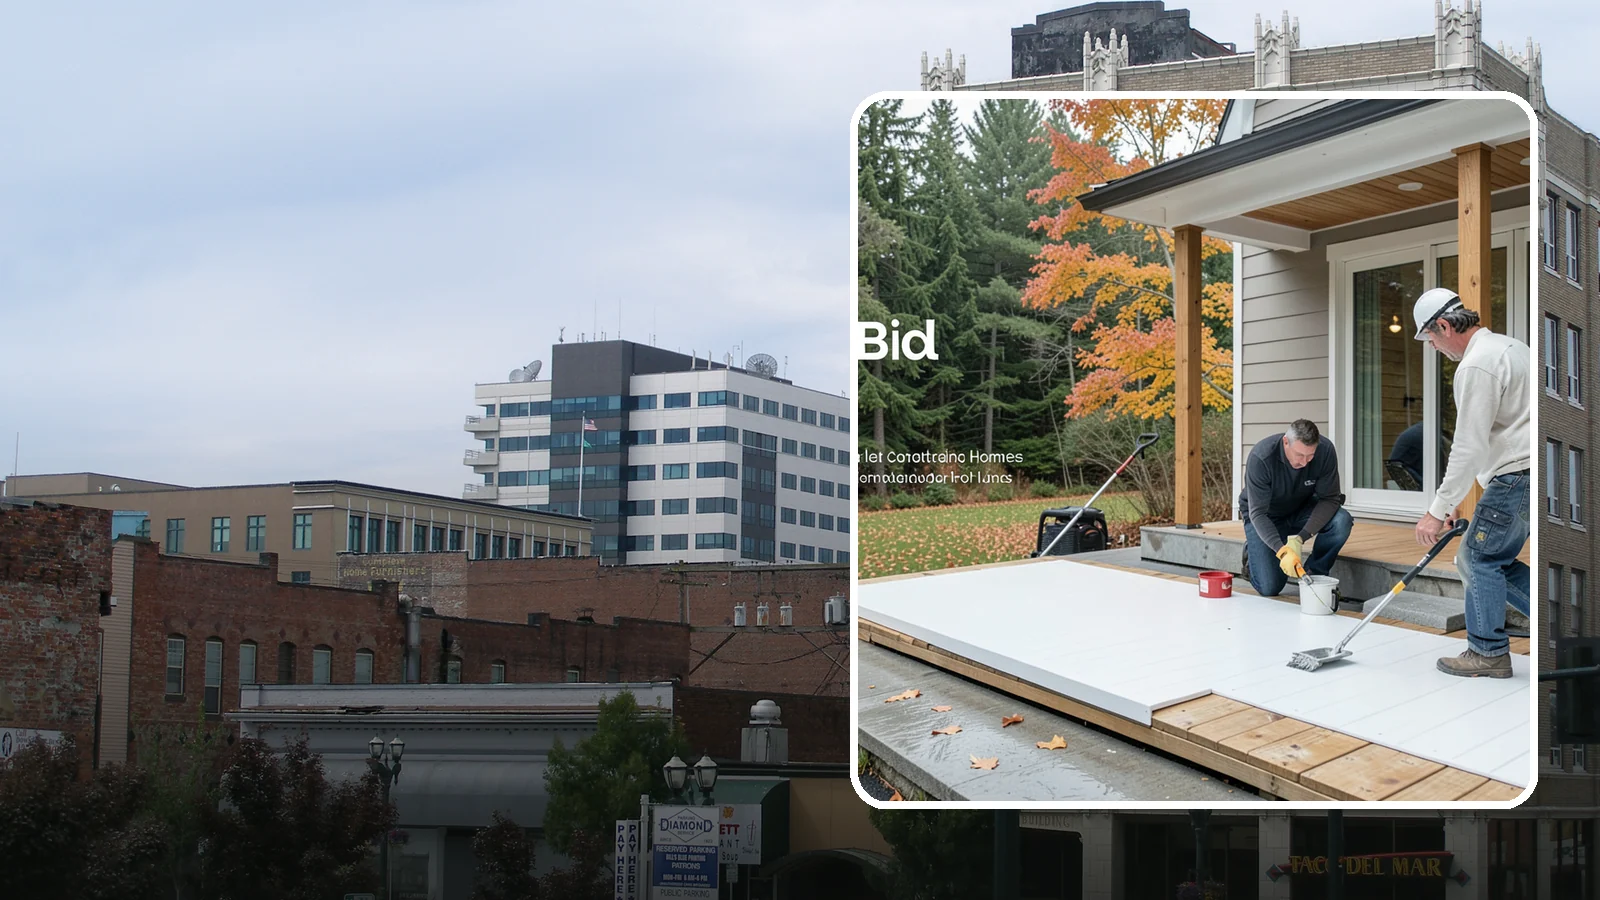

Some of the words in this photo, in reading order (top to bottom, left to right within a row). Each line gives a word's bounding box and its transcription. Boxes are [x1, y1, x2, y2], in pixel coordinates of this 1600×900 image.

[343, 567, 368, 577] Home
[370, 566, 427, 577] Furnishers
[660, 818, 713, 833] DIAMOND
[1021, 815, 1070, 828] BUILDING
[617, 825, 625, 852] PAY
[628, 824, 637, 852] PAY
[655, 845, 688, 853] RESERVED
[689, 846, 716, 854] PARKING
[671, 862, 701, 870] PATRONS
[1346, 856, 1385, 876] DEL
[1392, 857, 1442, 877] MAR
[616, 856, 625, 893] HERE
[628, 855, 636, 893] HERE
[660, 888, 682, 897] PUBLIC
[683, 889, 710, 898] PARKING
